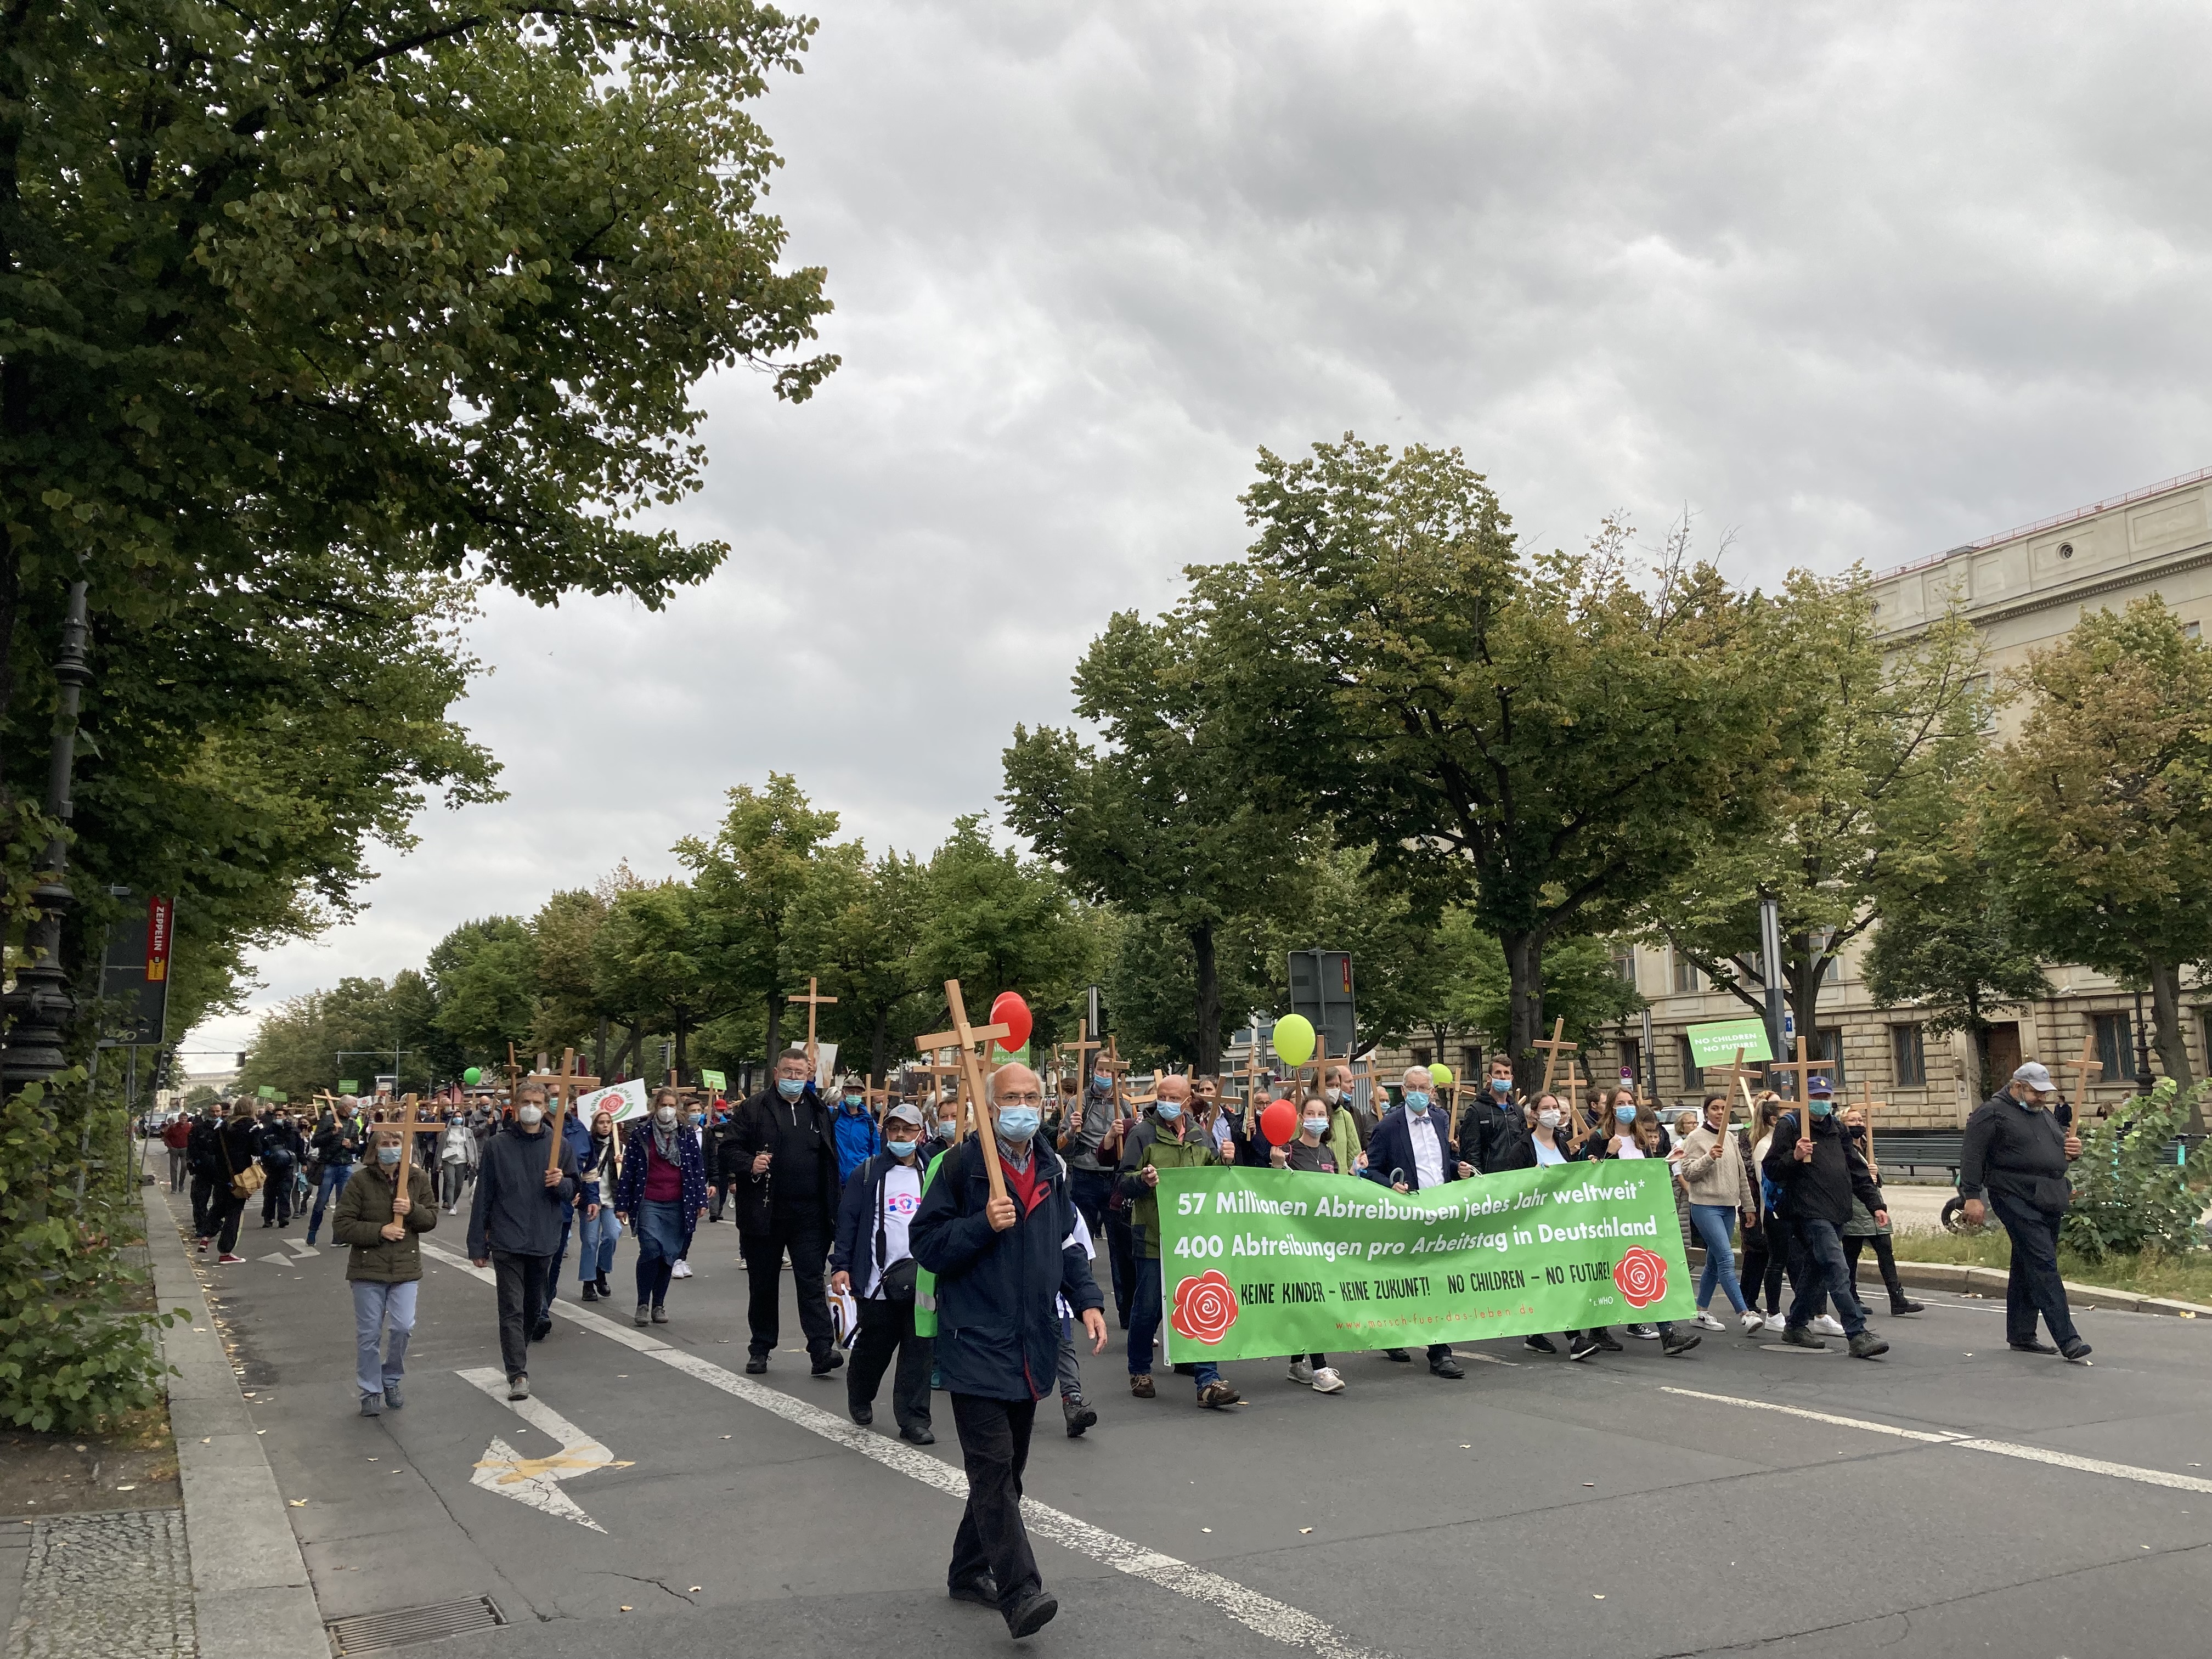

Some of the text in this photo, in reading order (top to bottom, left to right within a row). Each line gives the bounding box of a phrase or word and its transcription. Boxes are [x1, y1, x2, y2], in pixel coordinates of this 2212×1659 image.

[154, 906, 164, 951] ZEPPELIN
[1712, 1032, 1757, 1043] CHILDREN
[590, 1090, 608, 1111] DANKE
[1178, 1193, 1206, 1215] 57
[1216, 1189, 1307, 1216] Millionen
[1314, 1195, 1460, 1226] Abtreibungen
[1463, 1194, 1510, 1222] jedes
[1513, 1188, 1548, 1210] Jahr
[1174, 1215, 1657, 1262] 400 Abtreibungen pro Arbeitstag in Deutschland
[1241, 1283, 1274, 1305] KEINE
[1283, 1282, 1325, 1304] KINDER
[1339, 1281, 1370, 1302] KEINE
[1374, 1276, 1430, 1299] ZUKUNFT!
[1447, 1274, 1465, 1294] NO
[1470, 1269, 1525, 1292] CHILDREN
[1545, 1266, 1565, 1285] NO
[1569, 1261, 1610, 1283] FUTURE!
[1598, 1296, 1613, 1305] WHO
